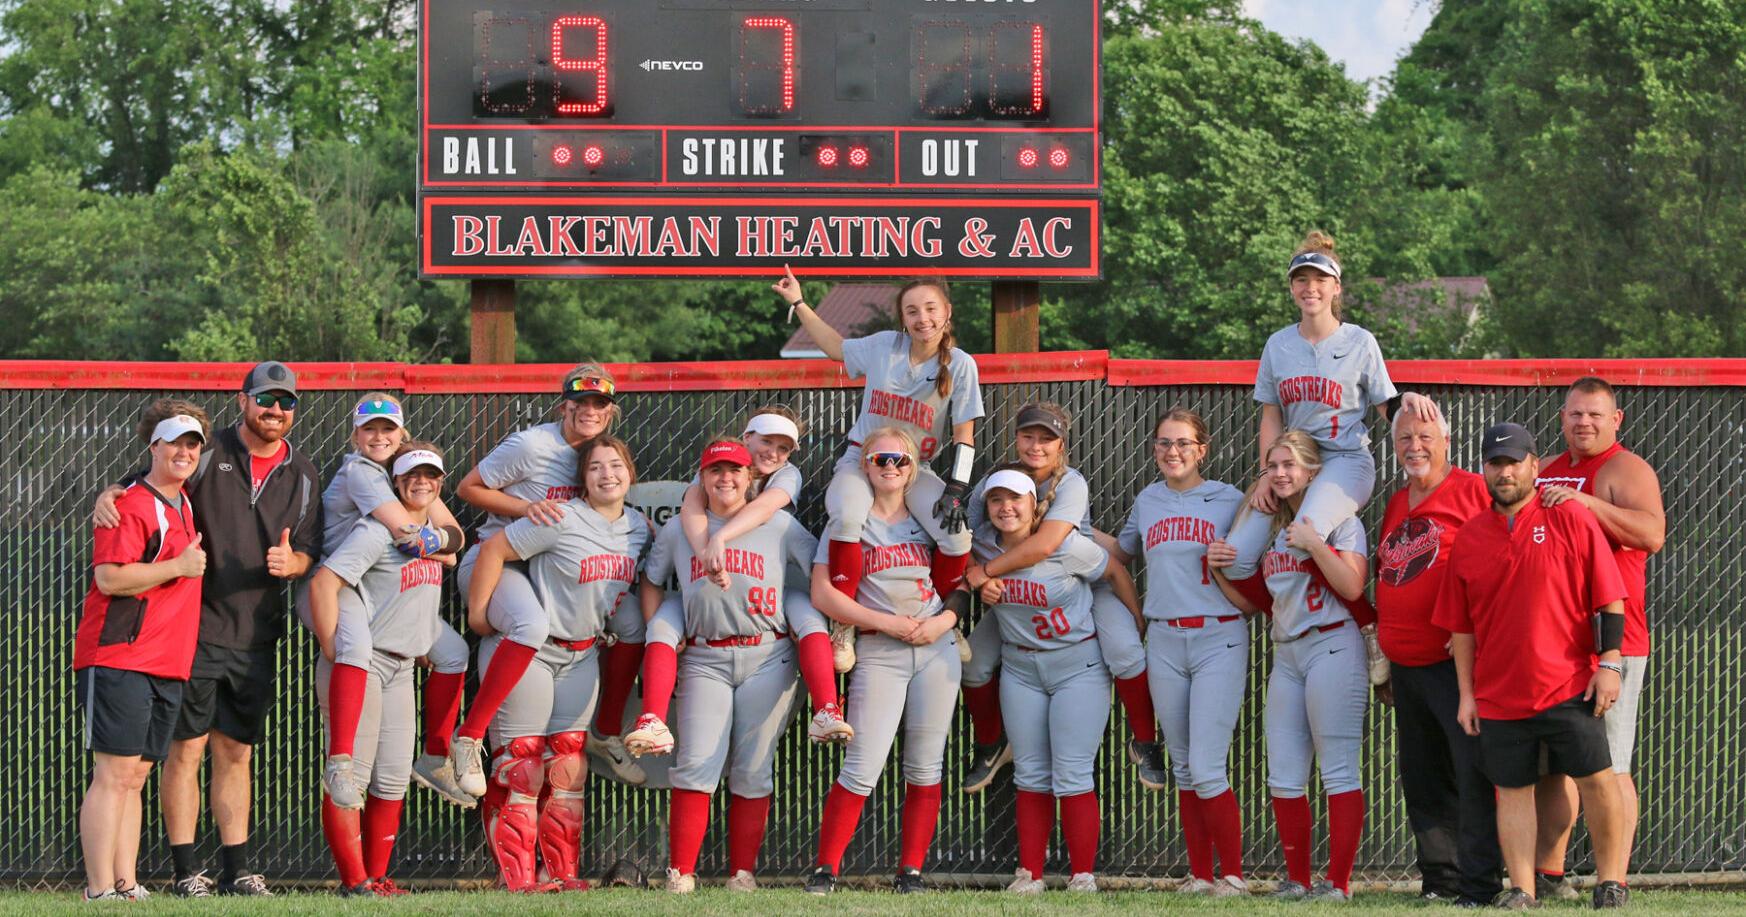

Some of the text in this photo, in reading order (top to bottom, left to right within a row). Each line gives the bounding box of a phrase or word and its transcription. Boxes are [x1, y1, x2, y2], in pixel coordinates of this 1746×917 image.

[553, 16, 607, 114] 9
[650, 60, 704, 71] NEVCO
[744, 17, 794, 111] 7
[1032, 24, 1043, 112] 1
[443, 137, 517, 175] BALL
[682, 138, 785, 176] STRIKE
[921, 139, 979, 177] OUT
[452, 214, 1074, 259] BLAKEMAN HEATING & AC
[1280, 375, 1343, 409] REDSTREAKS
[1329, 414, 1339, 439] 1
[1146, 516, 1216, 552] REDSTREAKS
[746, 586, 778, 617] 99
[1031, 606, 1072, 640] 20
